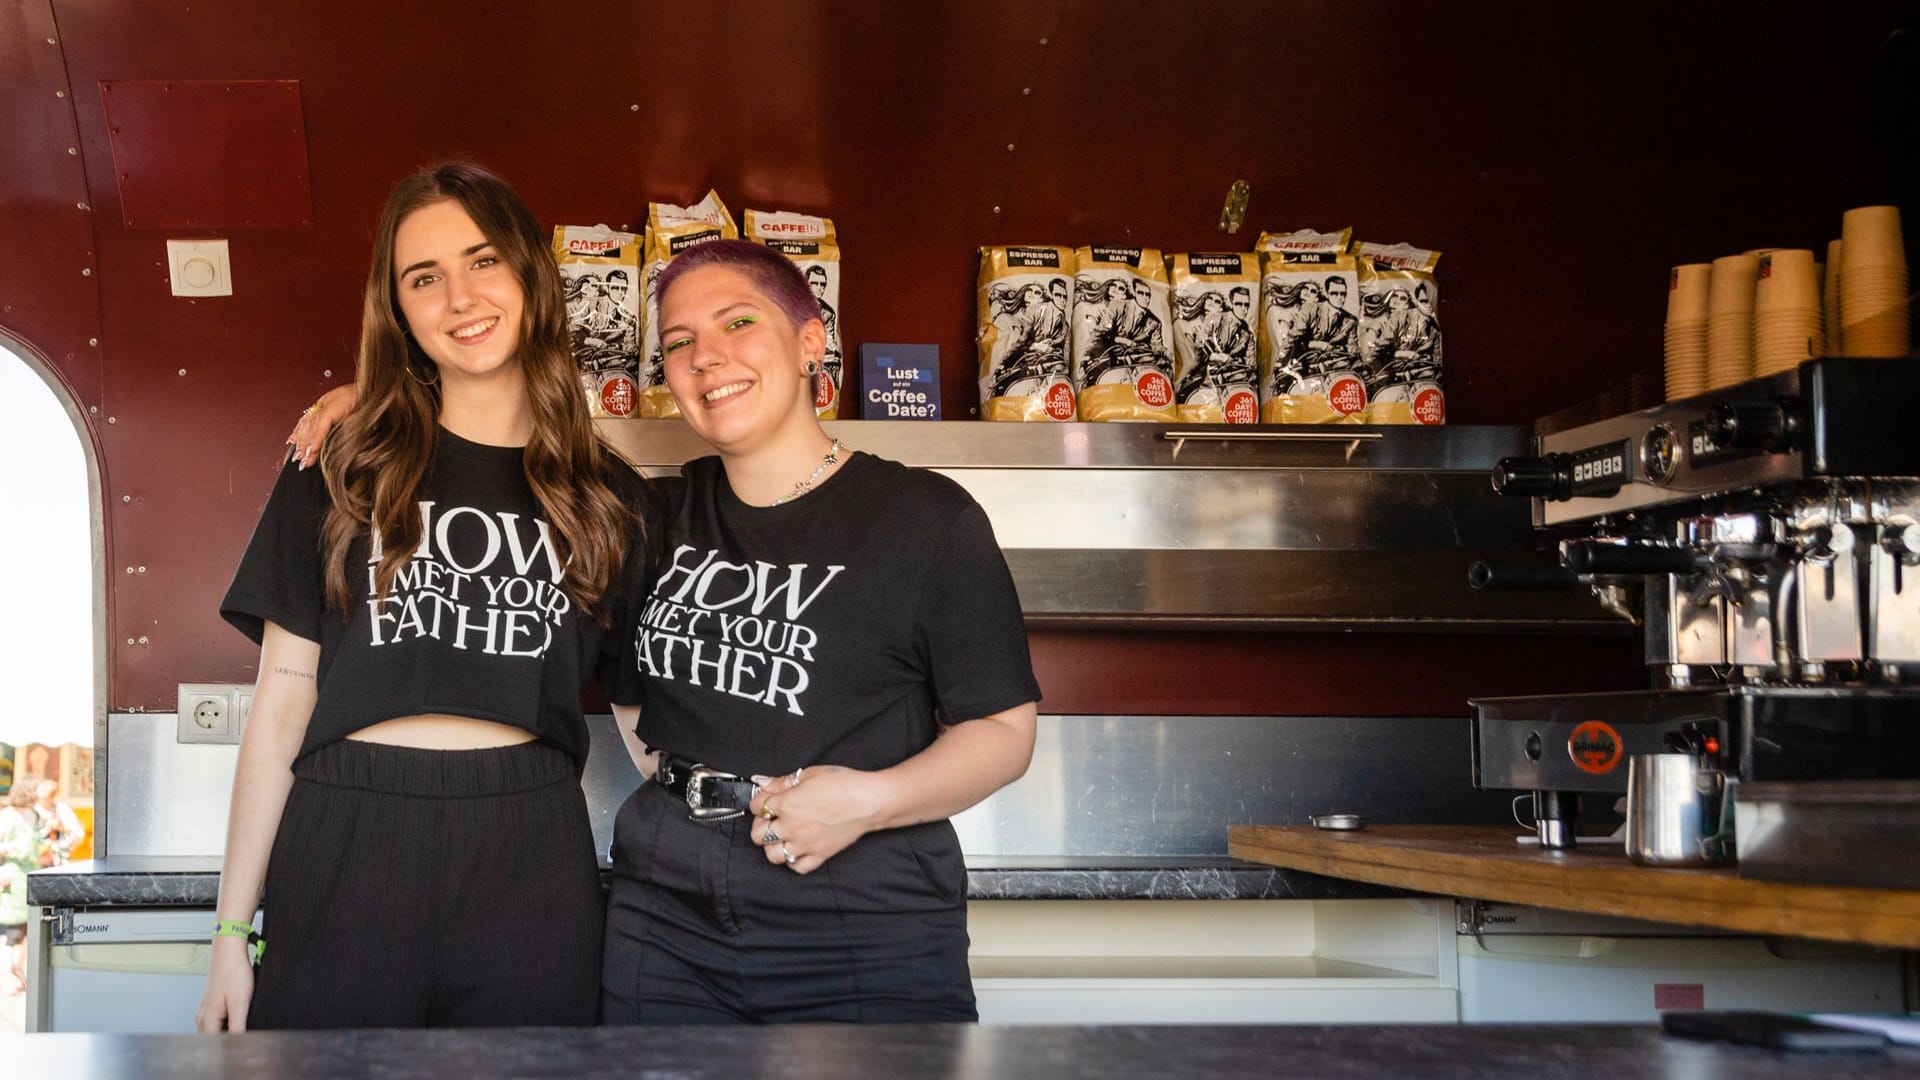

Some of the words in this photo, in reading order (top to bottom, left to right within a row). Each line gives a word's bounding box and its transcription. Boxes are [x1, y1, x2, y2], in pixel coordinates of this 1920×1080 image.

[761, 223, 820, 233] CAFFEIN
[783, 245, 802, 254] BAR
[1093, 248, 1140, 258] ESPRESSO
[1009, 250, 1057, 260] ESPRESSO
[1300, 254, 1320, 262] BAR
[887, 367, 919, 379] Lust
[1151, 376, 1165, 384] 365
[1146, 382, 1165, 391] DAYS
[868, 389, 927, 403] Coffee
[1140, 389, 1166, 397] COFFEE
[887, 403, 937, 417] Date?
[1047, 401, 1071, 409] COFFEE
[653, 544, 846, 621] HOW
[390, 560, 471, 600] MET
[480, 576, 570, 627] YOUR
[719, 613, 818, 662] YOUR
